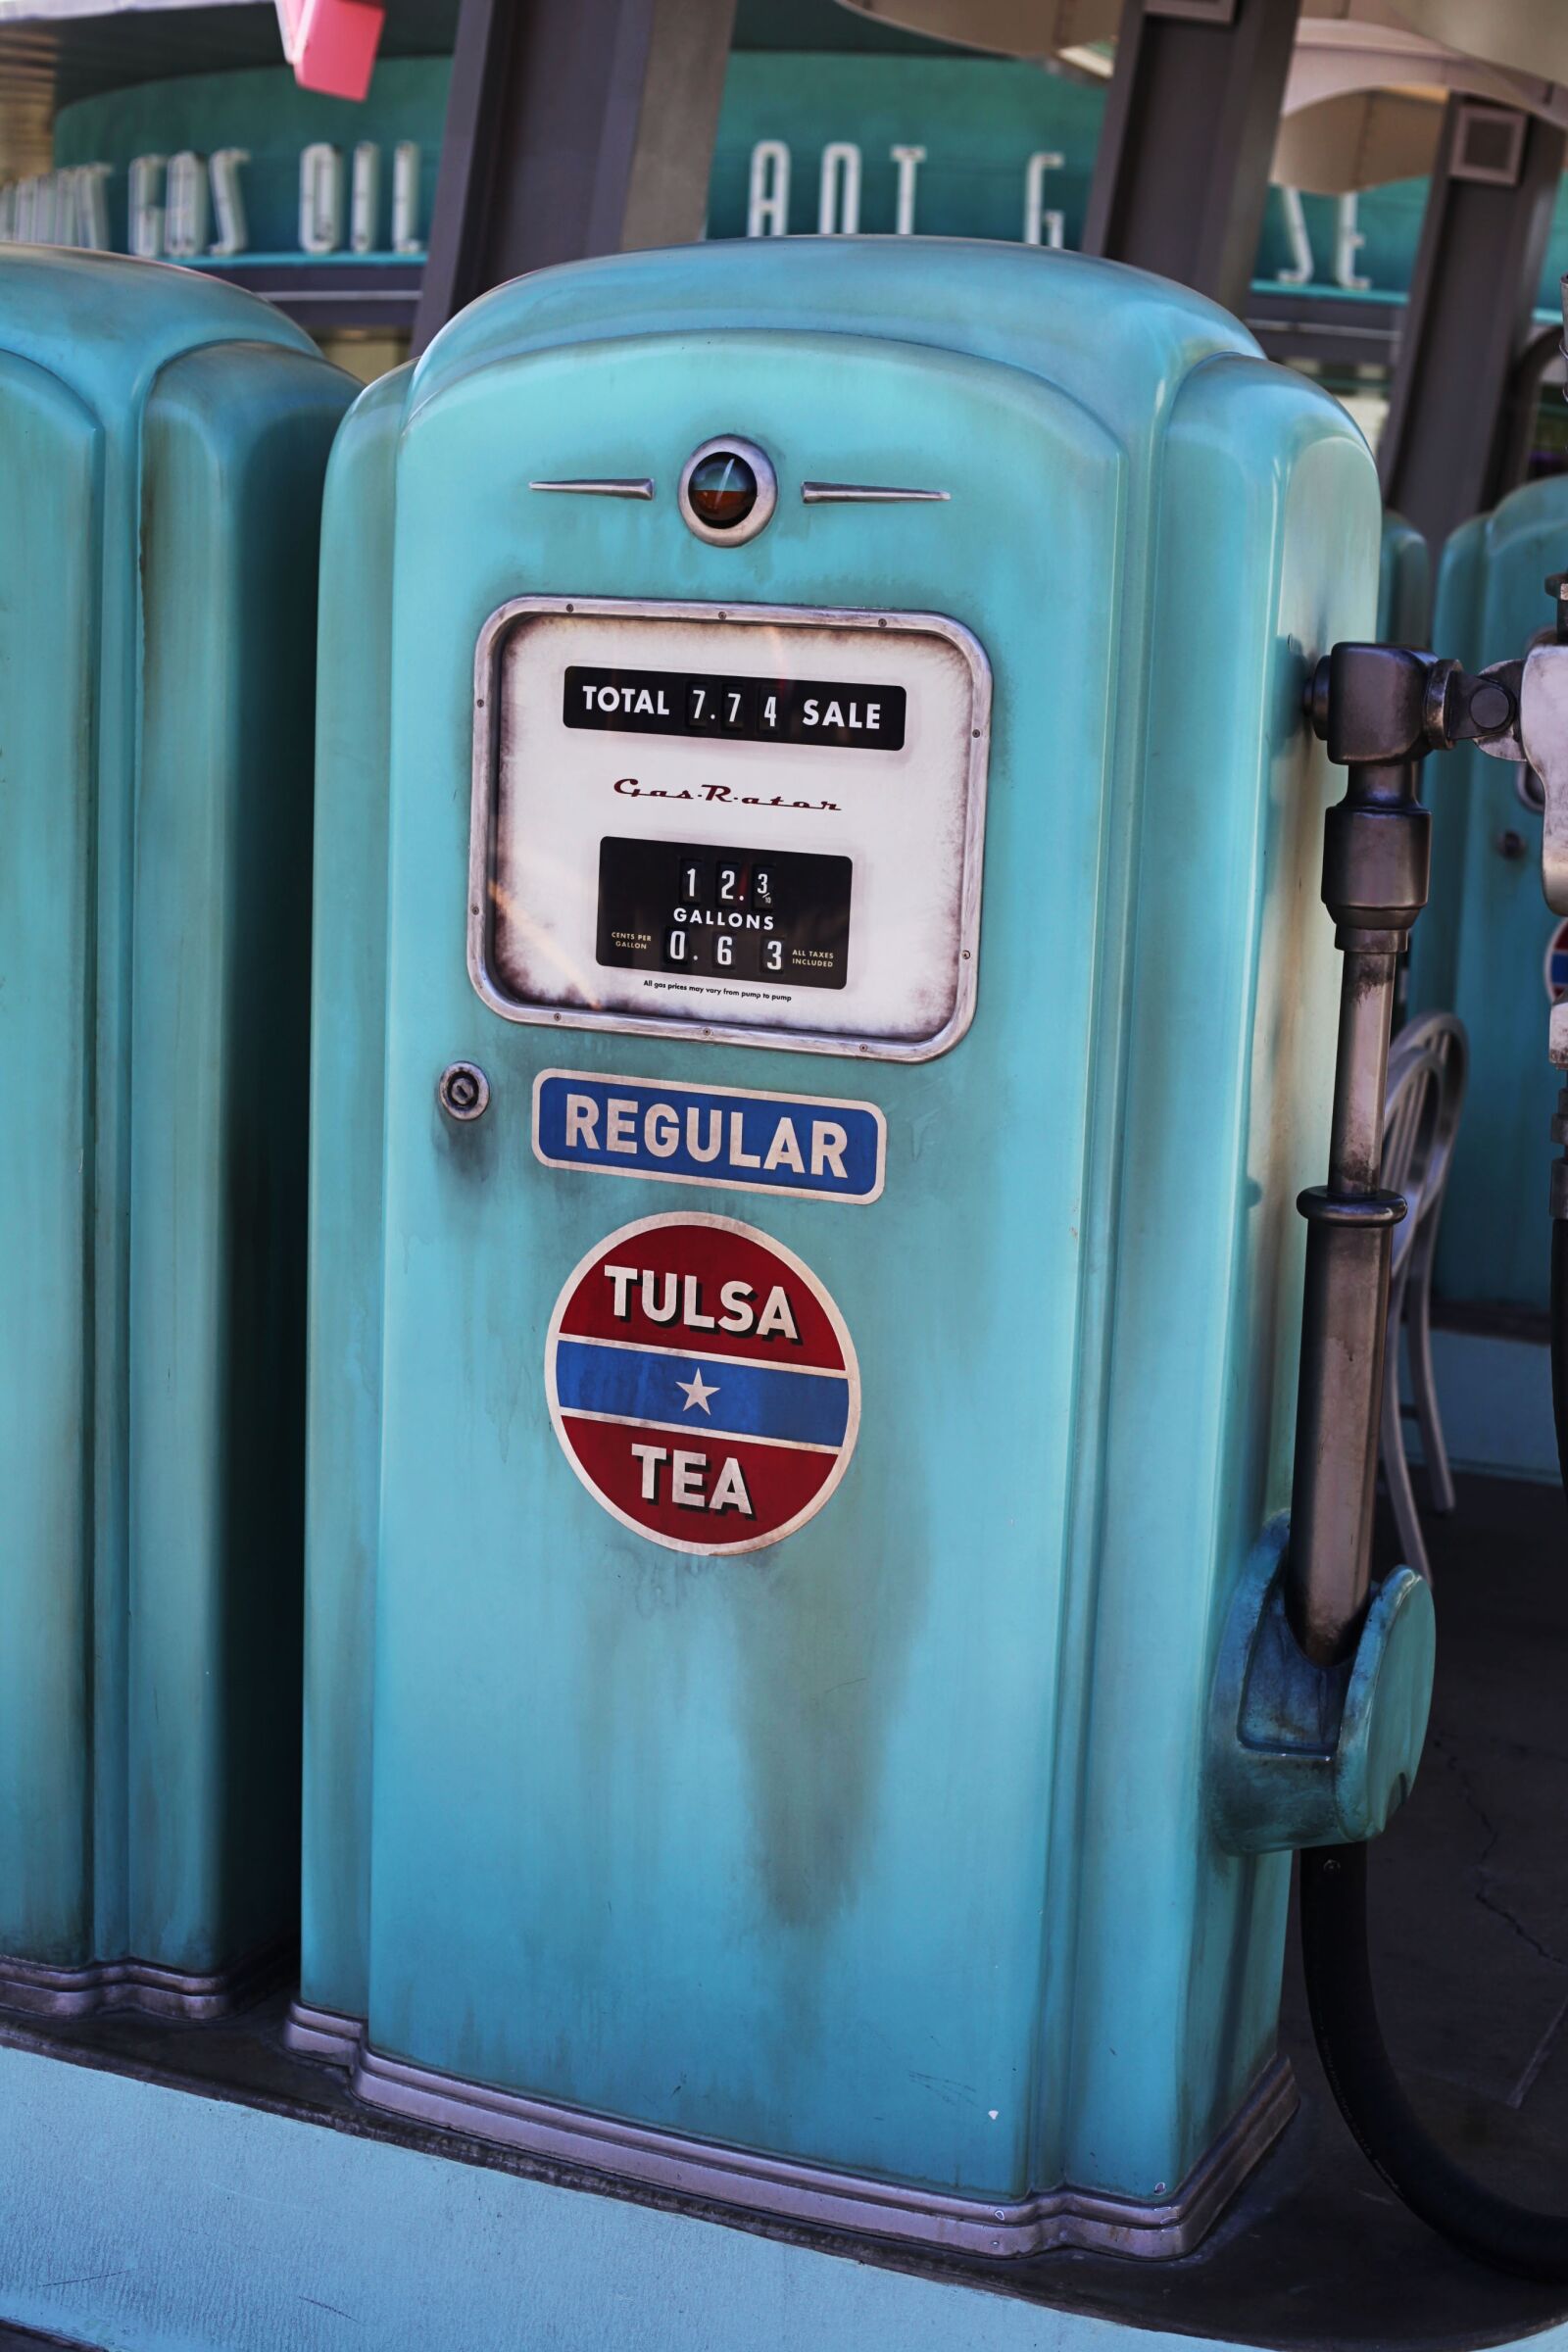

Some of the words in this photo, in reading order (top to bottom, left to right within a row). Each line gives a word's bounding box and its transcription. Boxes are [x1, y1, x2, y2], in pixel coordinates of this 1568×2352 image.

[299, 140, 422, 255] OIL
[582, 686, 670, 715] TOTAL
[803, 700, 881, 729] SALE
[673, 907, 774, 931] GALLONS
[612, 931, 635, 940] CENTS
[615, 941, 647, 950] GALLON
[792, 957, 834, 967] INCLUDED
[808, 951, 834, 959] TAXES
[667, 982, 688, 991] prices
[741, 991, 761, 1000] pump
[564, 1093, 849, 1178] REGULAR
[604, 1264, 803, 1346] TULSA
[631, 1443, 757, 1520] TEA
